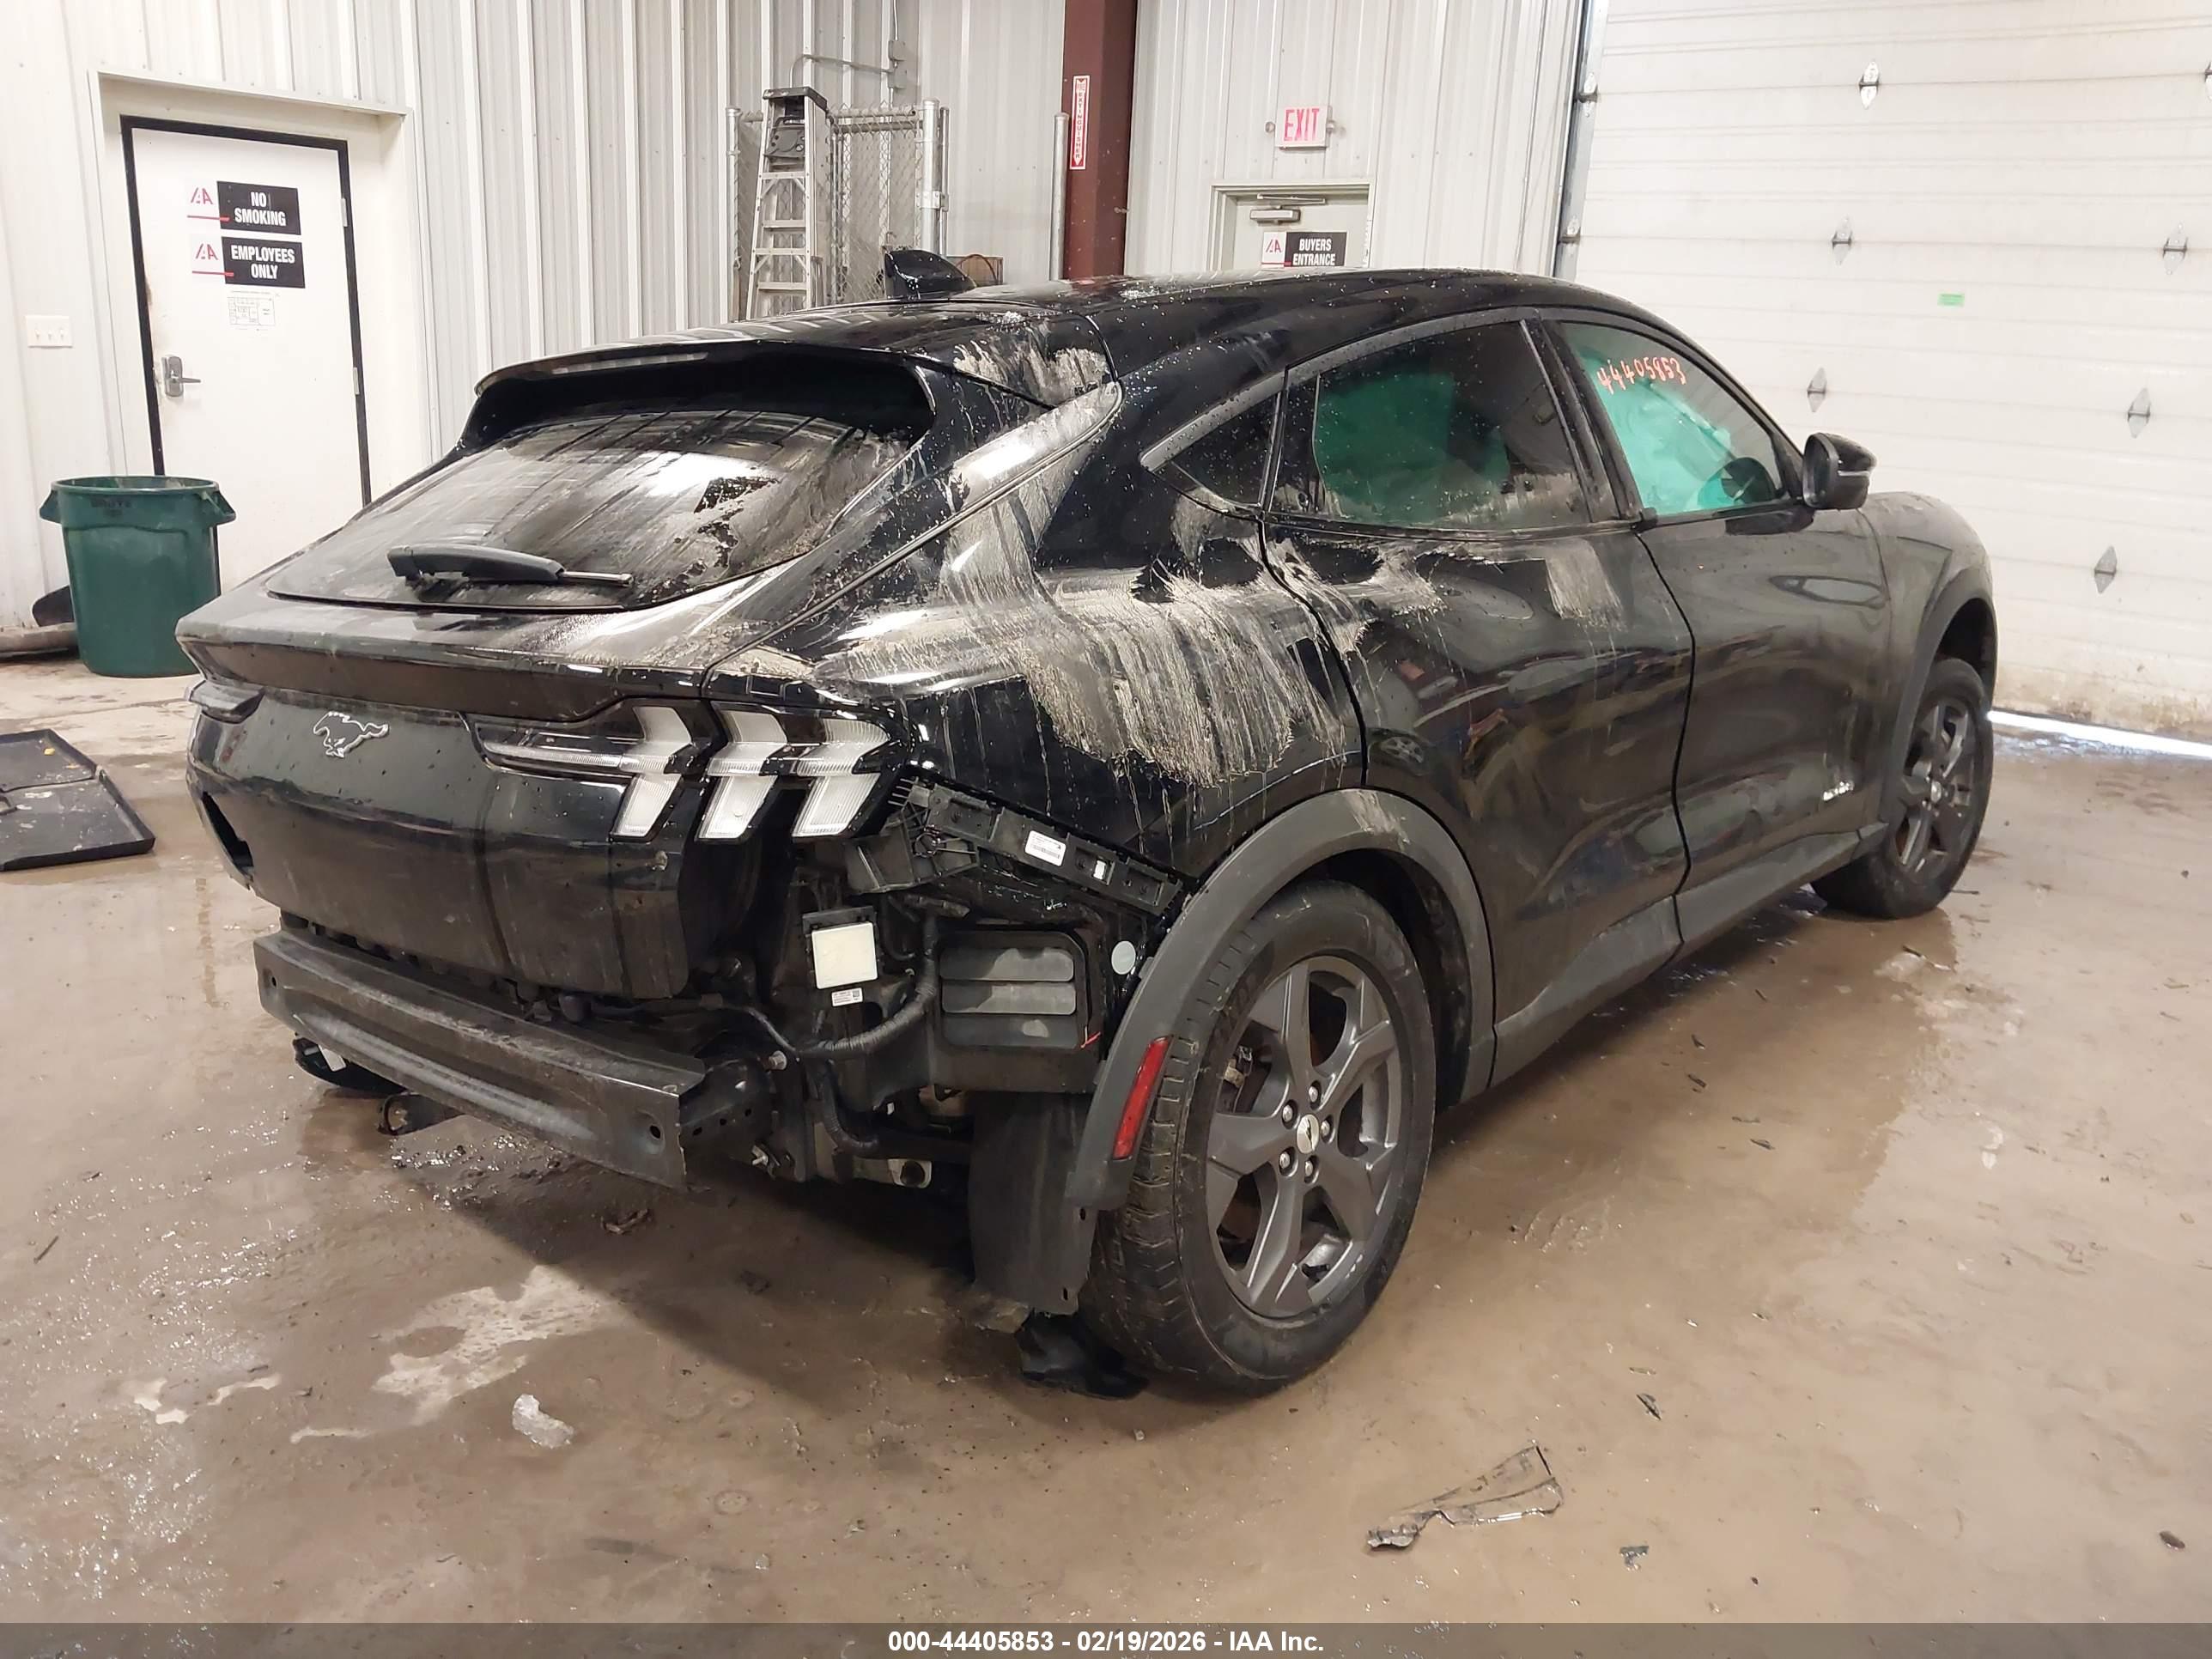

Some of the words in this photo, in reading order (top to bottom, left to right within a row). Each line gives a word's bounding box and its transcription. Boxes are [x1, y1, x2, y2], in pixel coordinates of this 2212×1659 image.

[1284, 108, 1319, 141] EXIT
[251, 191, 267, 207] NO
[234, 208, 286, 226] SMOKING
[1298, 238, 1332, 252] BUYERS
[231, 245, 295, 264] EMPLOYEES
[1292, 252, 1335, 265] ENTRANCE
[251, 264, 278, 279] ONLY
[1597, 357, 1686, 395] 44405853
